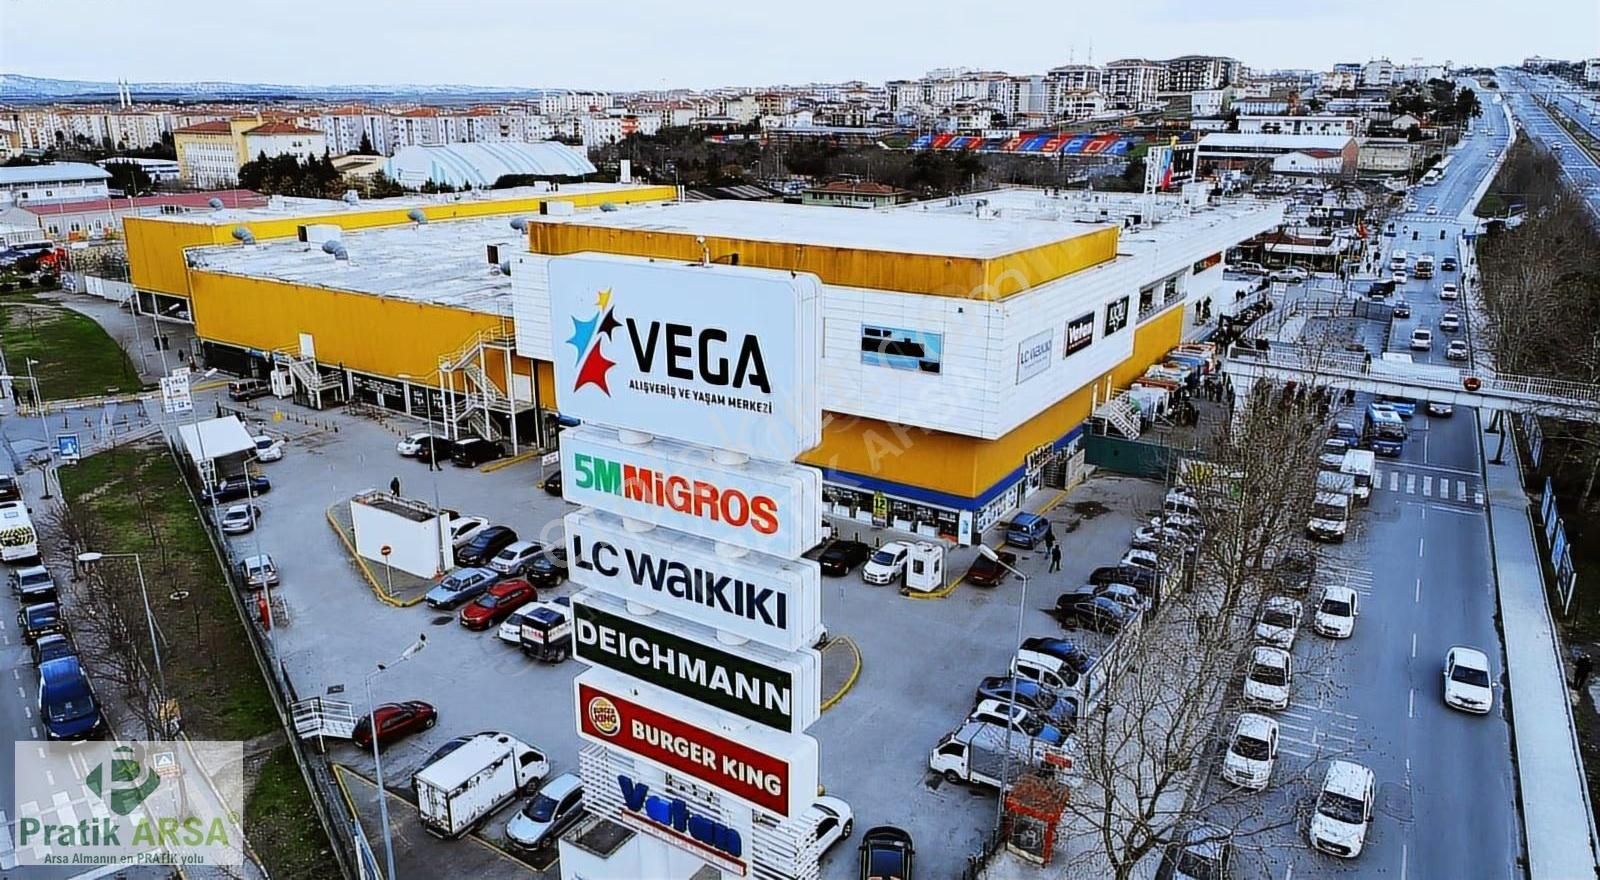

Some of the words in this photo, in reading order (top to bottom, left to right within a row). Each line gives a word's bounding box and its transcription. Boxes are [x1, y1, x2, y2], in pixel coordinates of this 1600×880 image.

[626, 318, 771, 393] VEGA
[629, 379, 676, 399] ALIŞVERİŞ
[678, 388, 691, 399] VE
[692, 390, 726, 406] YAŞAM
[727, 397, 773, 414] MERKEZİ
[573, 534, 620, 577] LC
[576, 617, 791, 716] DEICHMANN
[631, 719, 717, 771] BURGER
[722, 754, 782, 797] KING
